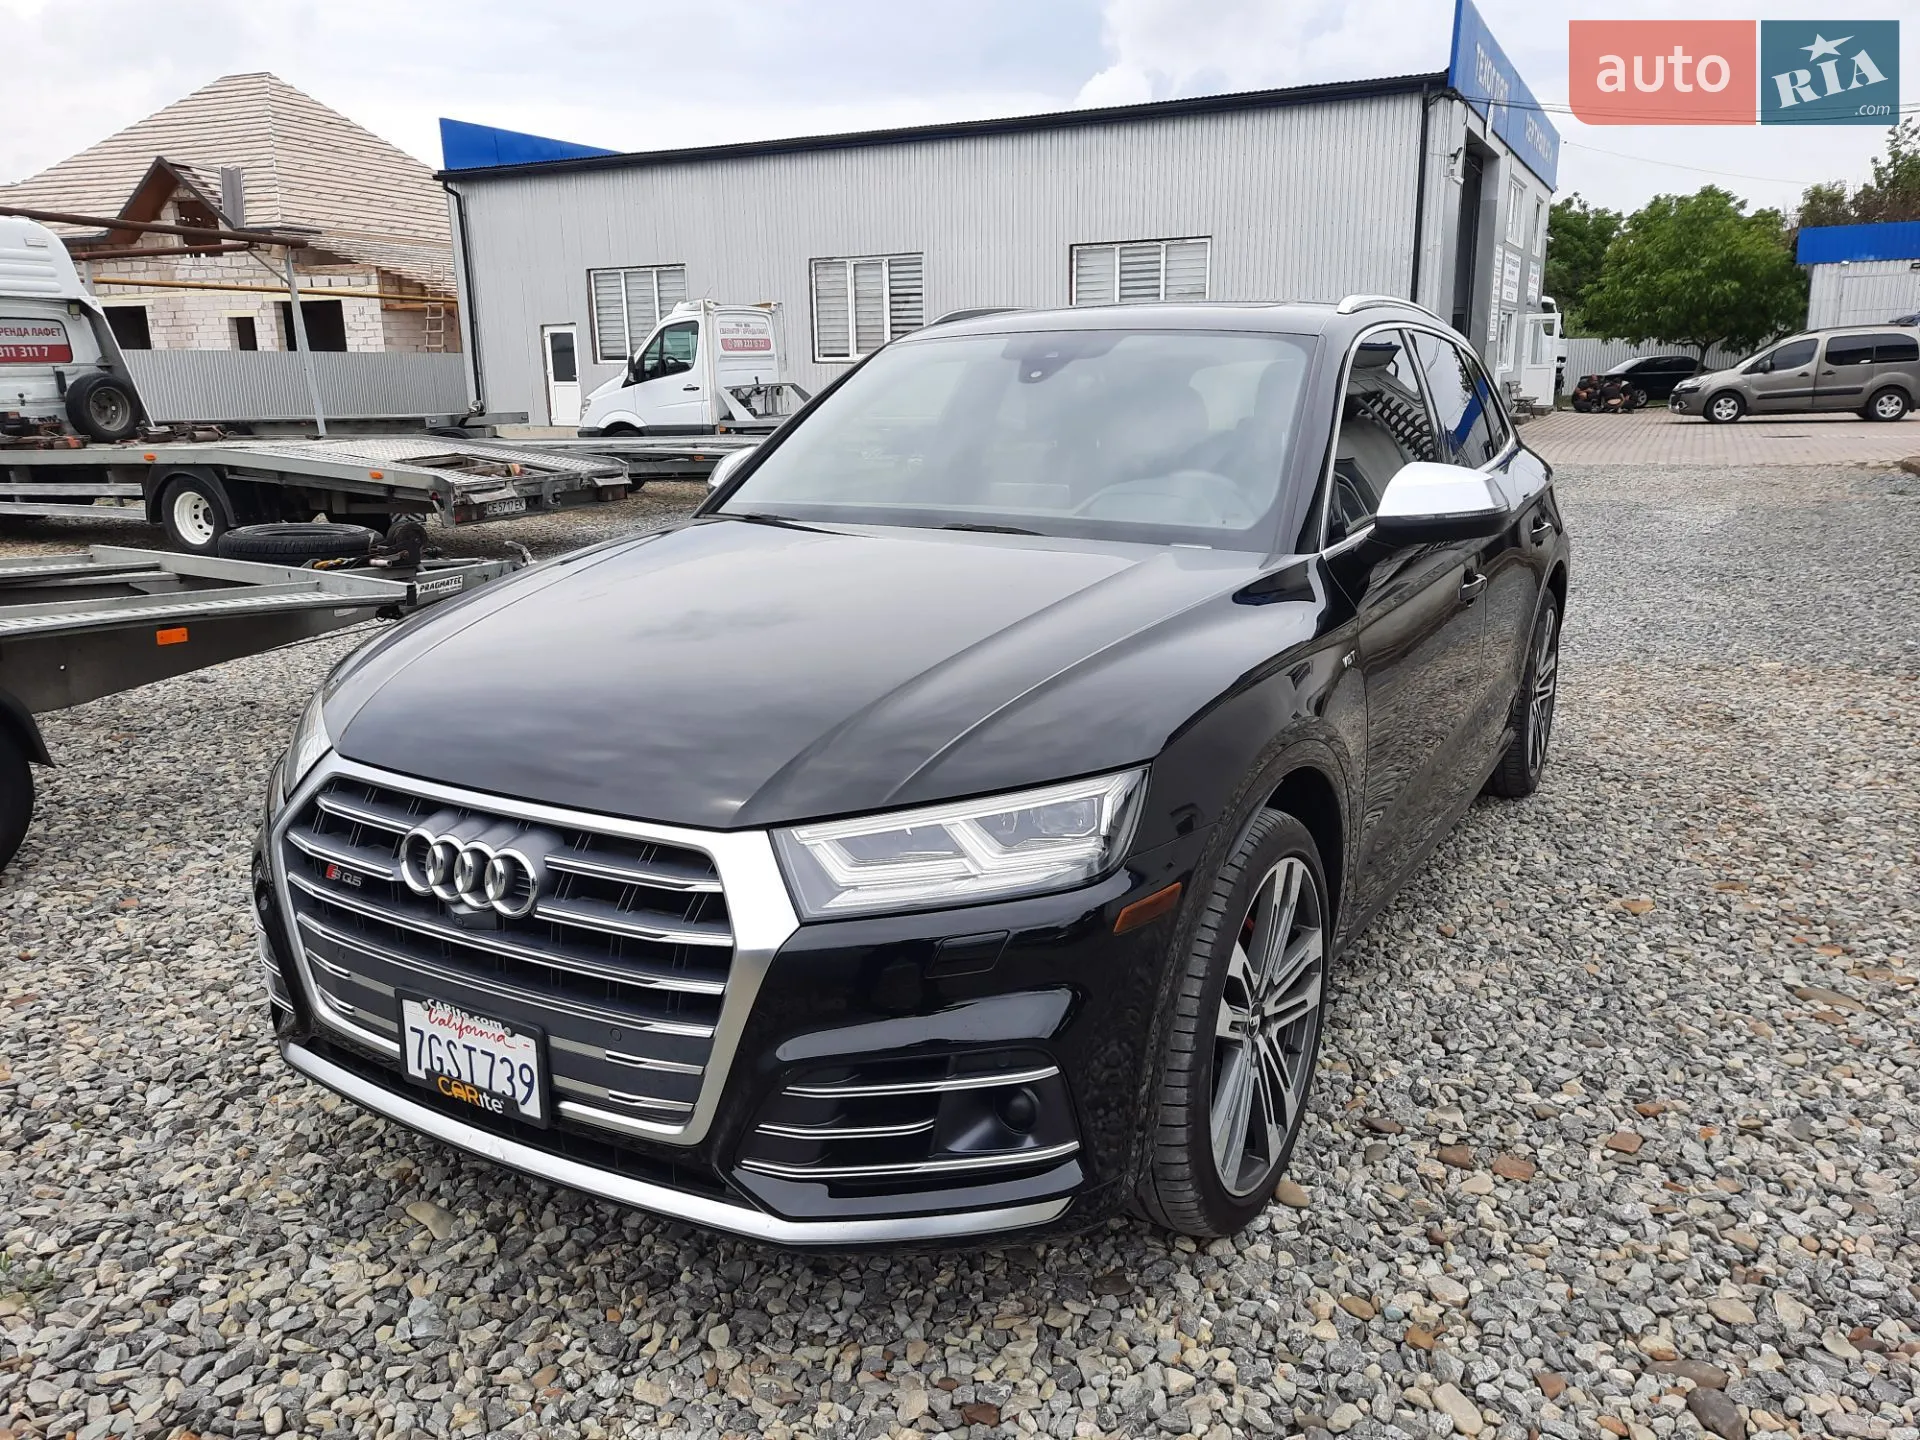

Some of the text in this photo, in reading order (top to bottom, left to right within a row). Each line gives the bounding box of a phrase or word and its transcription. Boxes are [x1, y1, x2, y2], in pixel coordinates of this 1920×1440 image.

[20, 346, 39, 357] 311
[41, 346, 49, 357] 7
[31, 327, 61, 337] ЛАФЕТ
[428, 1006, 516, 1049] California
[410, 1026, 535, 1106] 7GST739
[437, 1075, 504, 1114] CARite
